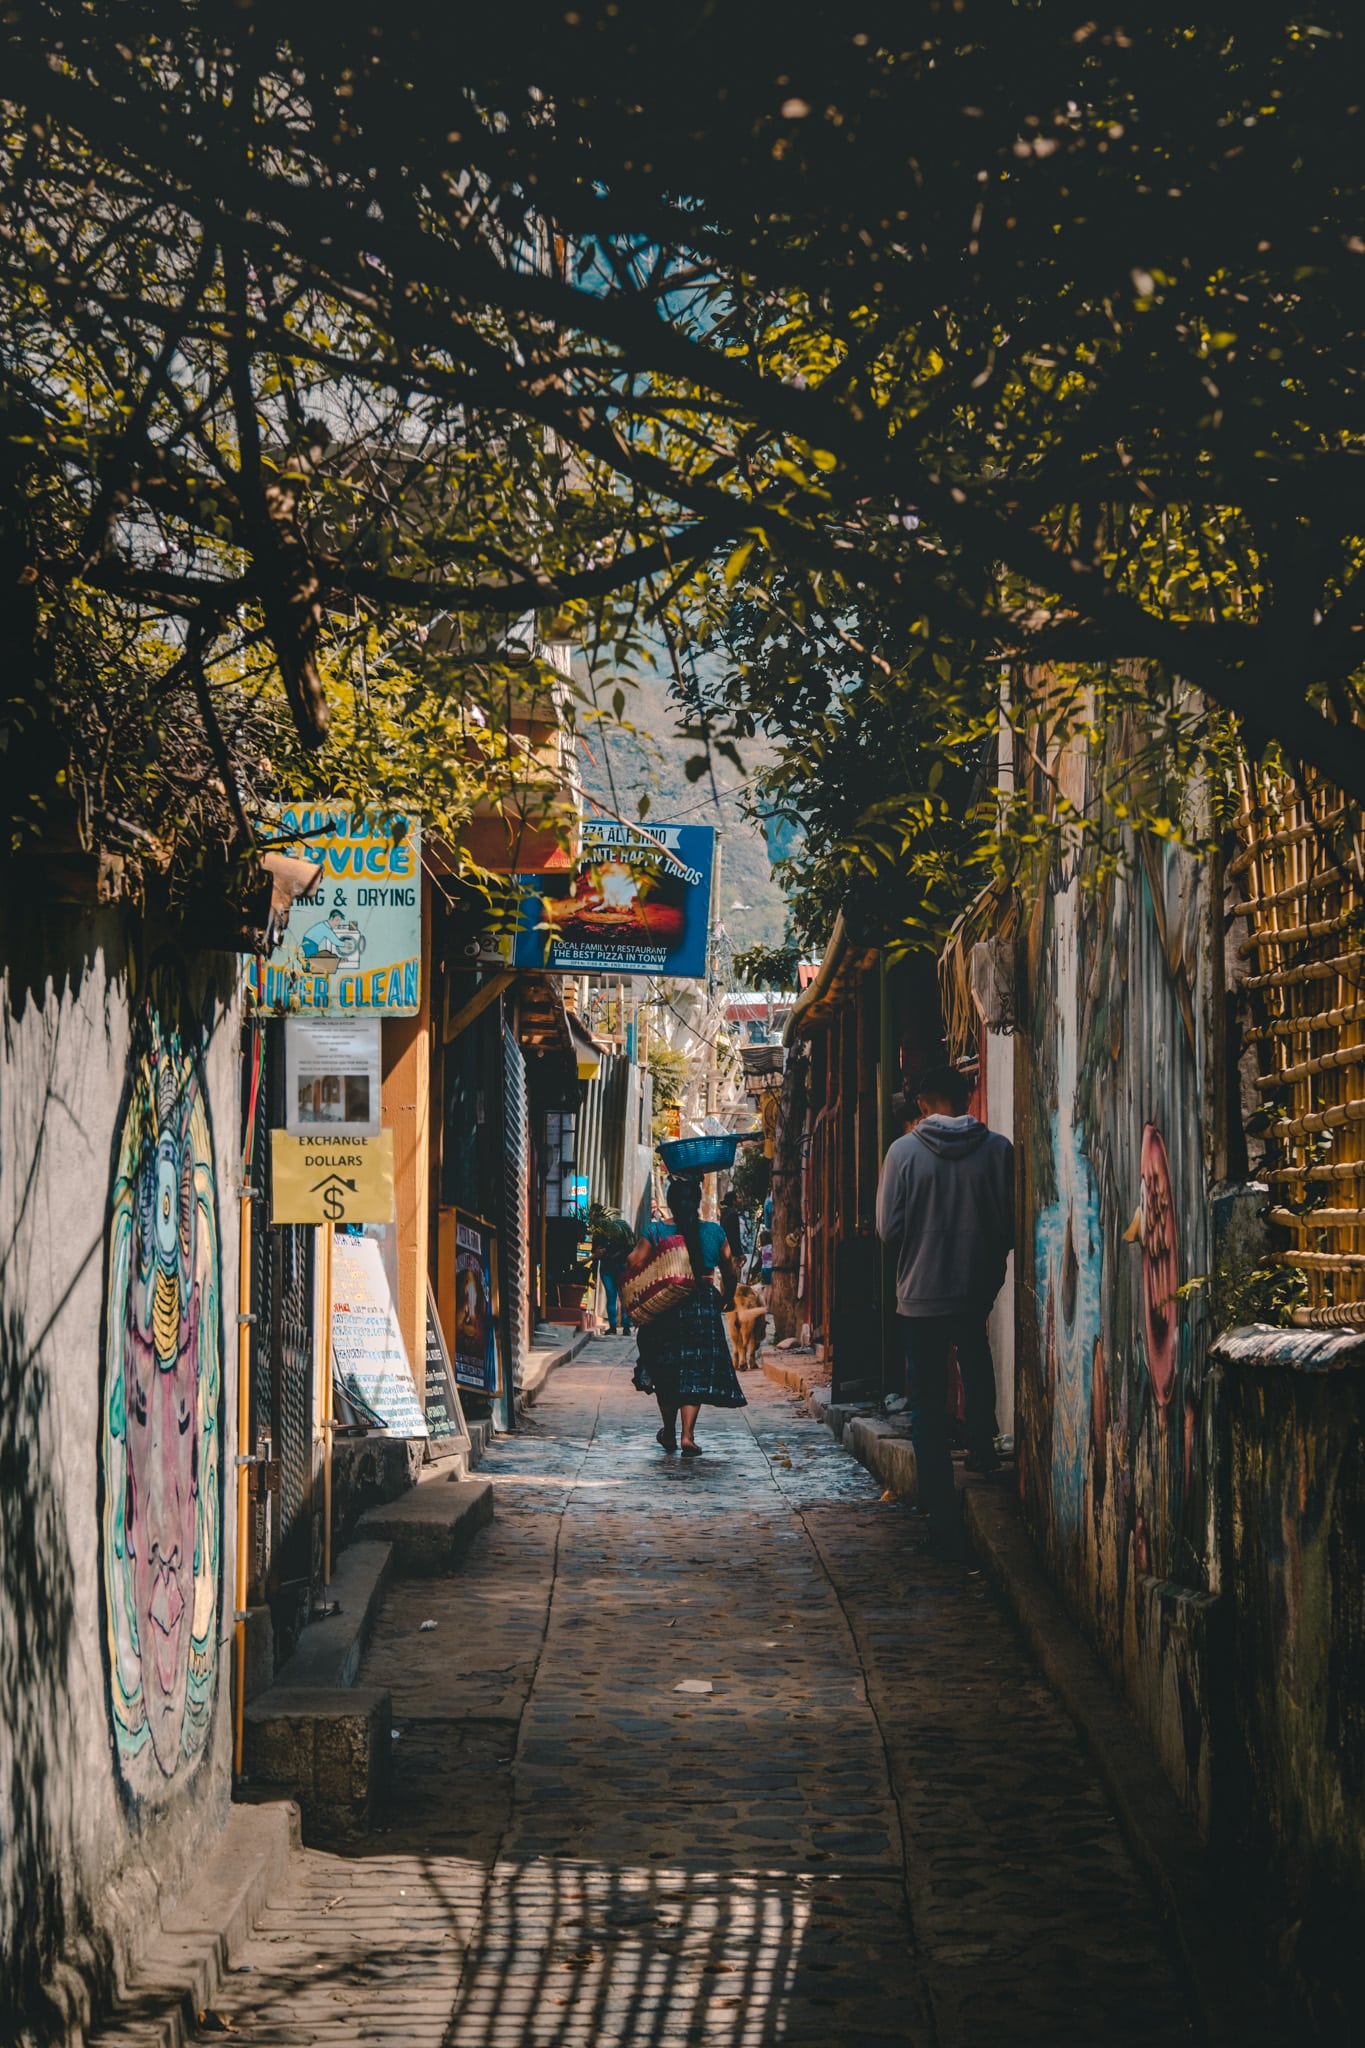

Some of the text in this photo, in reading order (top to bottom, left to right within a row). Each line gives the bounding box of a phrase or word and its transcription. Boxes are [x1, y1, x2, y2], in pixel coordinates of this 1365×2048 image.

[608, 827, 622, 843] AL
[581, 847, 618, 865] ANTE
[664, 858, 704, 886] TACOS
[333, 887, 348, 907] &
[357, 888, 415, 906] DRYING
[553, 941, 668, 955] LOCAL FAMILY Y RESTAURANT
[553, 949, 667, 963] THE BEST PIZZA IN TONW
[339, 958, 419, 1009] CLEAN
[299, 1136, 368, 1146] EXCHANGE
[305, 1155, 363, 1167] DOLLARS
